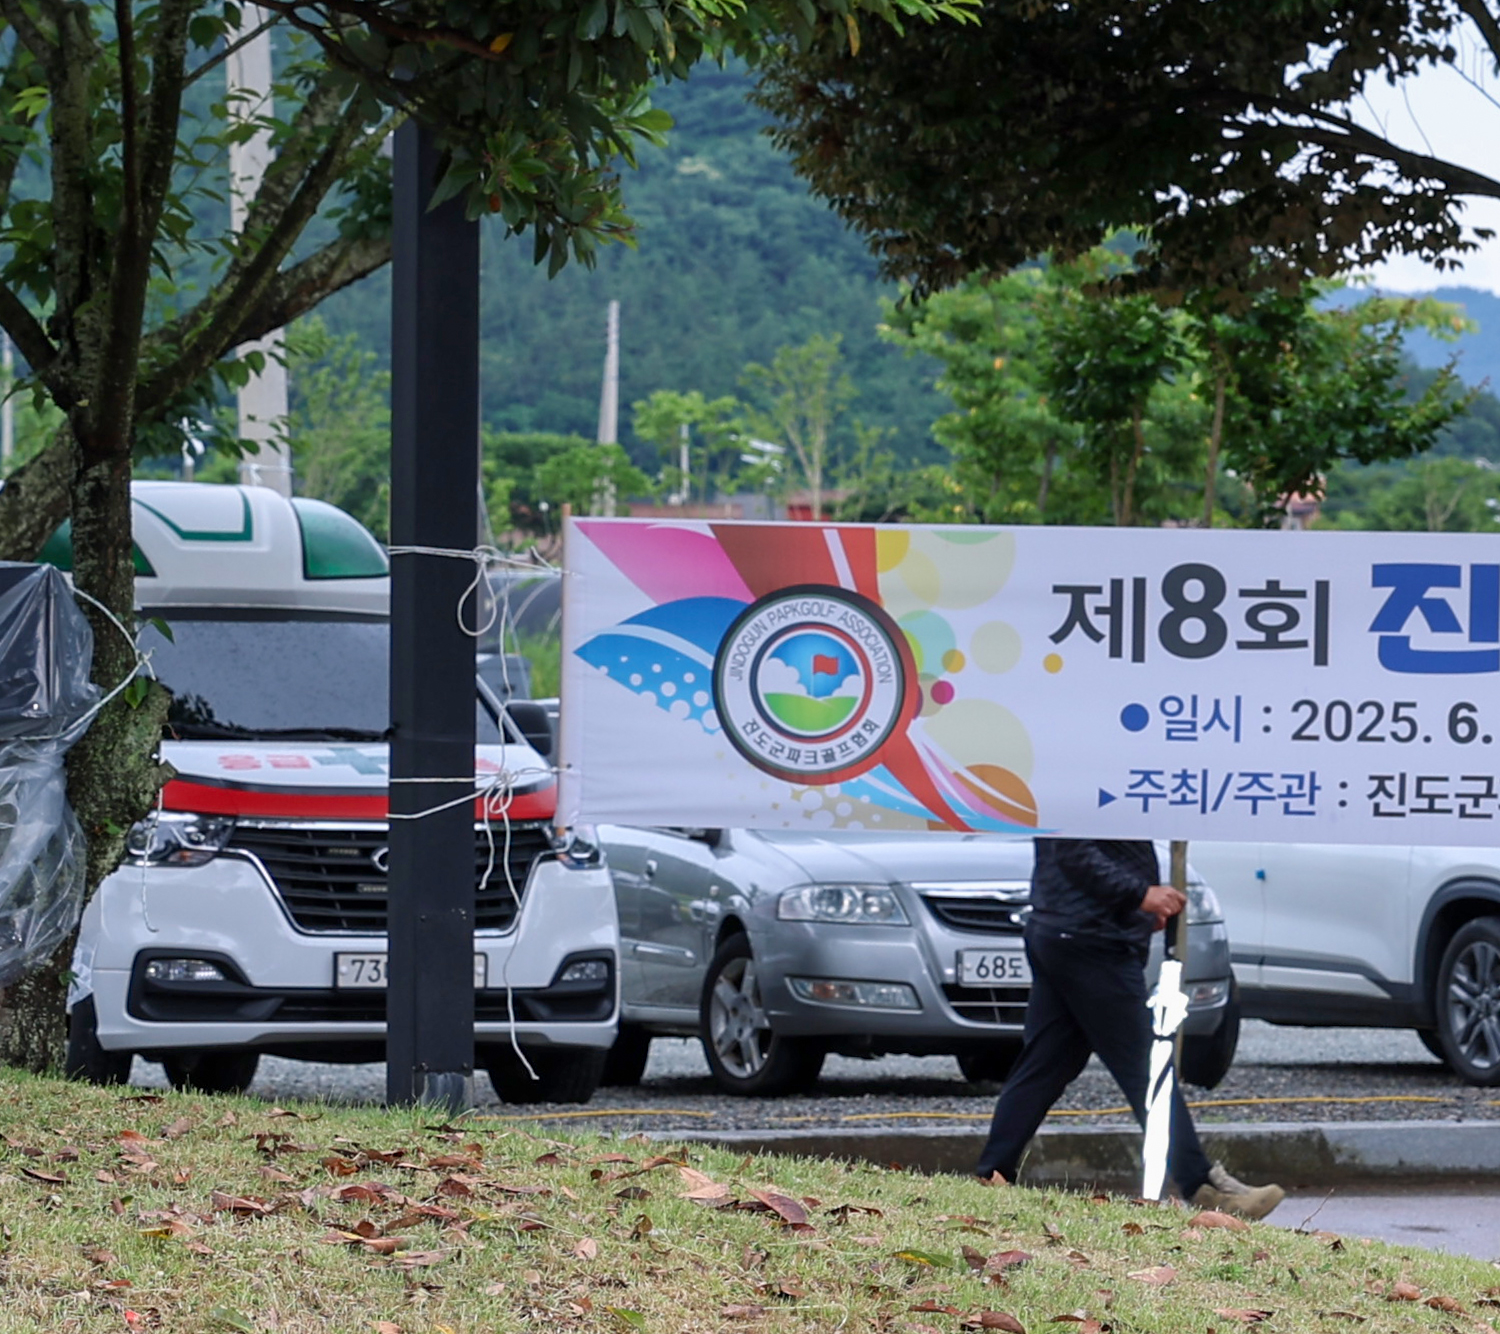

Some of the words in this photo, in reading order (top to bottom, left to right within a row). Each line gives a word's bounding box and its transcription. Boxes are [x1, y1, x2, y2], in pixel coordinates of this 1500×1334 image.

[1048, 563, 1331, 667] 제8회
[729, 618, 768, 681] JINDOGUN
[838, 610, 893, 684] ASSOCIATION
[1158, 694, 1243, 743] 일시
[1290, 699, 1432, 744] 2025.
[1447, 701, 1493, 745] 6.
[1124, 768, 1321, 816] 주최/주관
[351, 959, 388, 983] 73
[976, 955, 1023, 979] 68도
